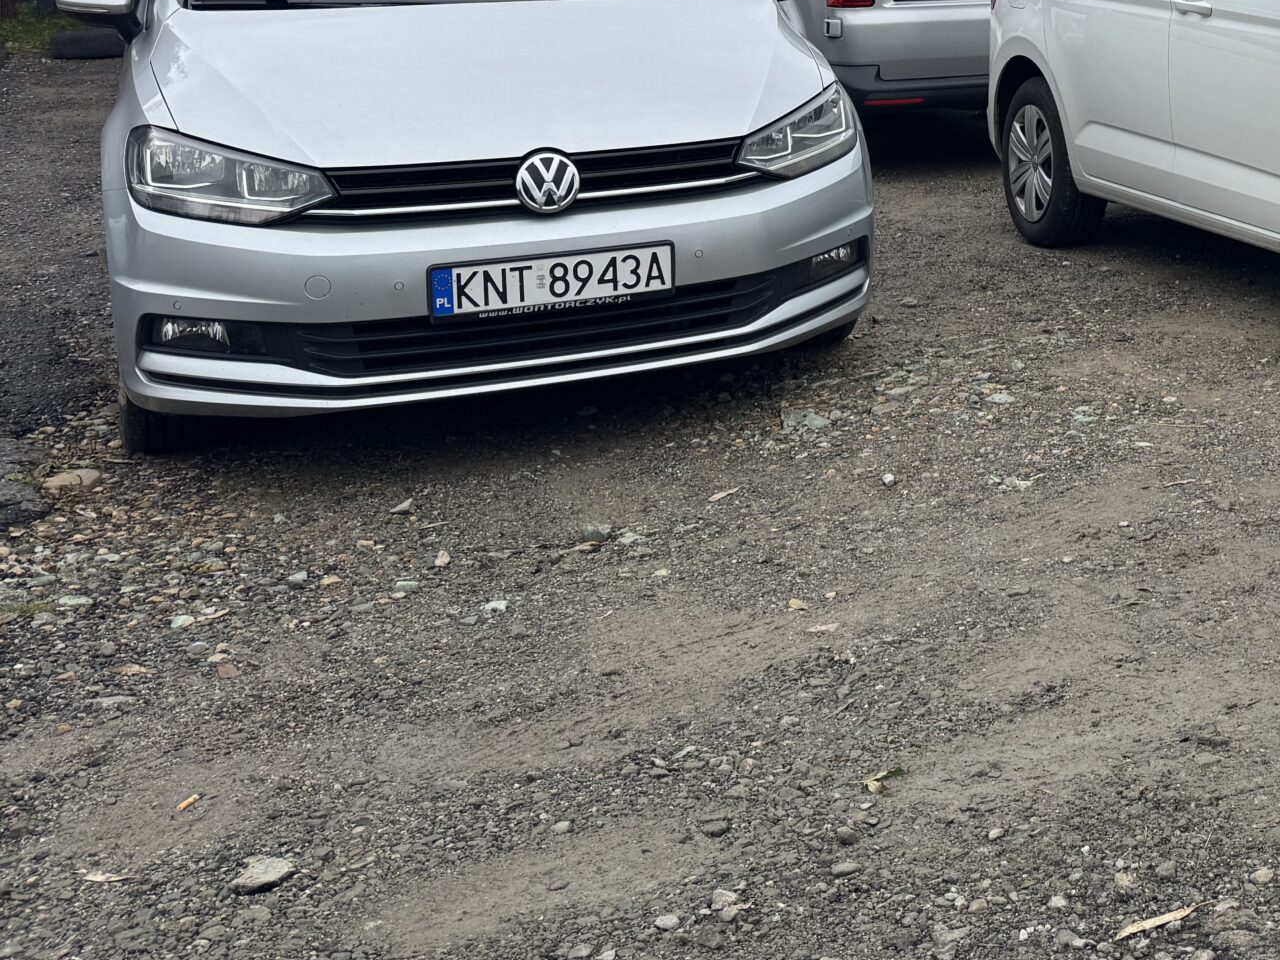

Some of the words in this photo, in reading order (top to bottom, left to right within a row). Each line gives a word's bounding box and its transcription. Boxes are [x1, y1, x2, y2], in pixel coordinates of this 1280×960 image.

[455, 265, 532, 309] KNT
[549, 251, 666, 298] 8943A
[436, 297, 451, 308] PL
